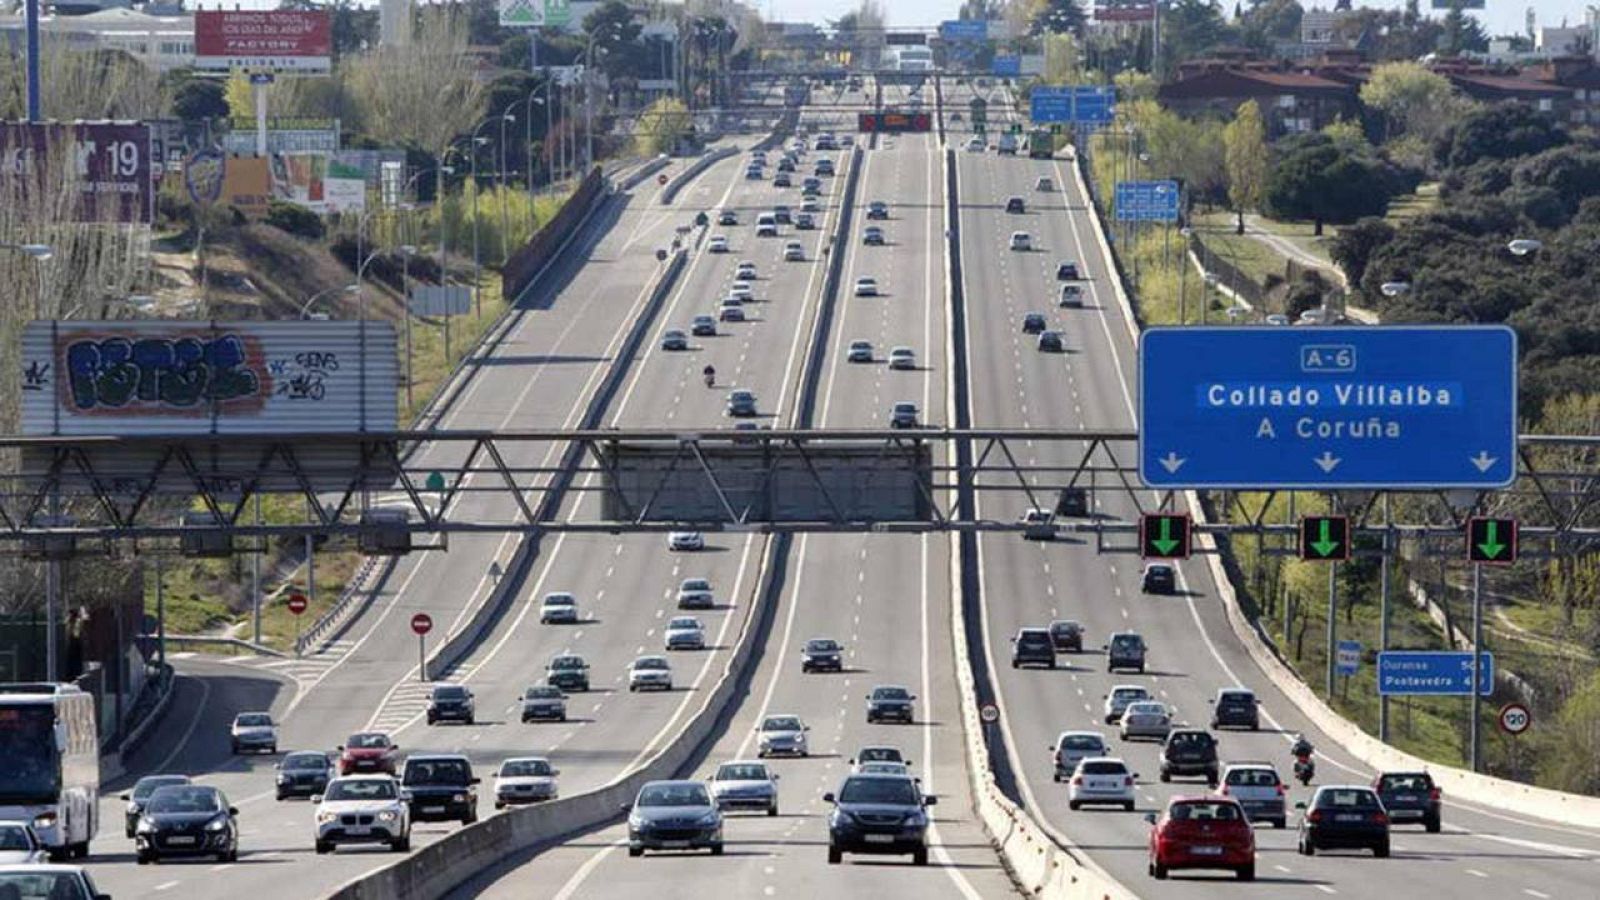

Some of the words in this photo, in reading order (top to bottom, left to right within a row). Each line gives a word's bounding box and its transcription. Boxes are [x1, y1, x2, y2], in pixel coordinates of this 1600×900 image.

[227, 40, 299, 49] FACTORY
[106, 140, 139, 176] 19
[1306, 350, 1351, 367] A-6
[1208, 384, 1320, 406] Collado
[1334, 384, 1451, 406] Villalba
[1256, 418, 1276, 438] A
[1296, 417, 1401, 438] Coruña
[1383, 660, 1429, 671] Ourense
[1385, 676, 1453, 686] Pontevedra
[1506, 713, 1525, 726] 120
